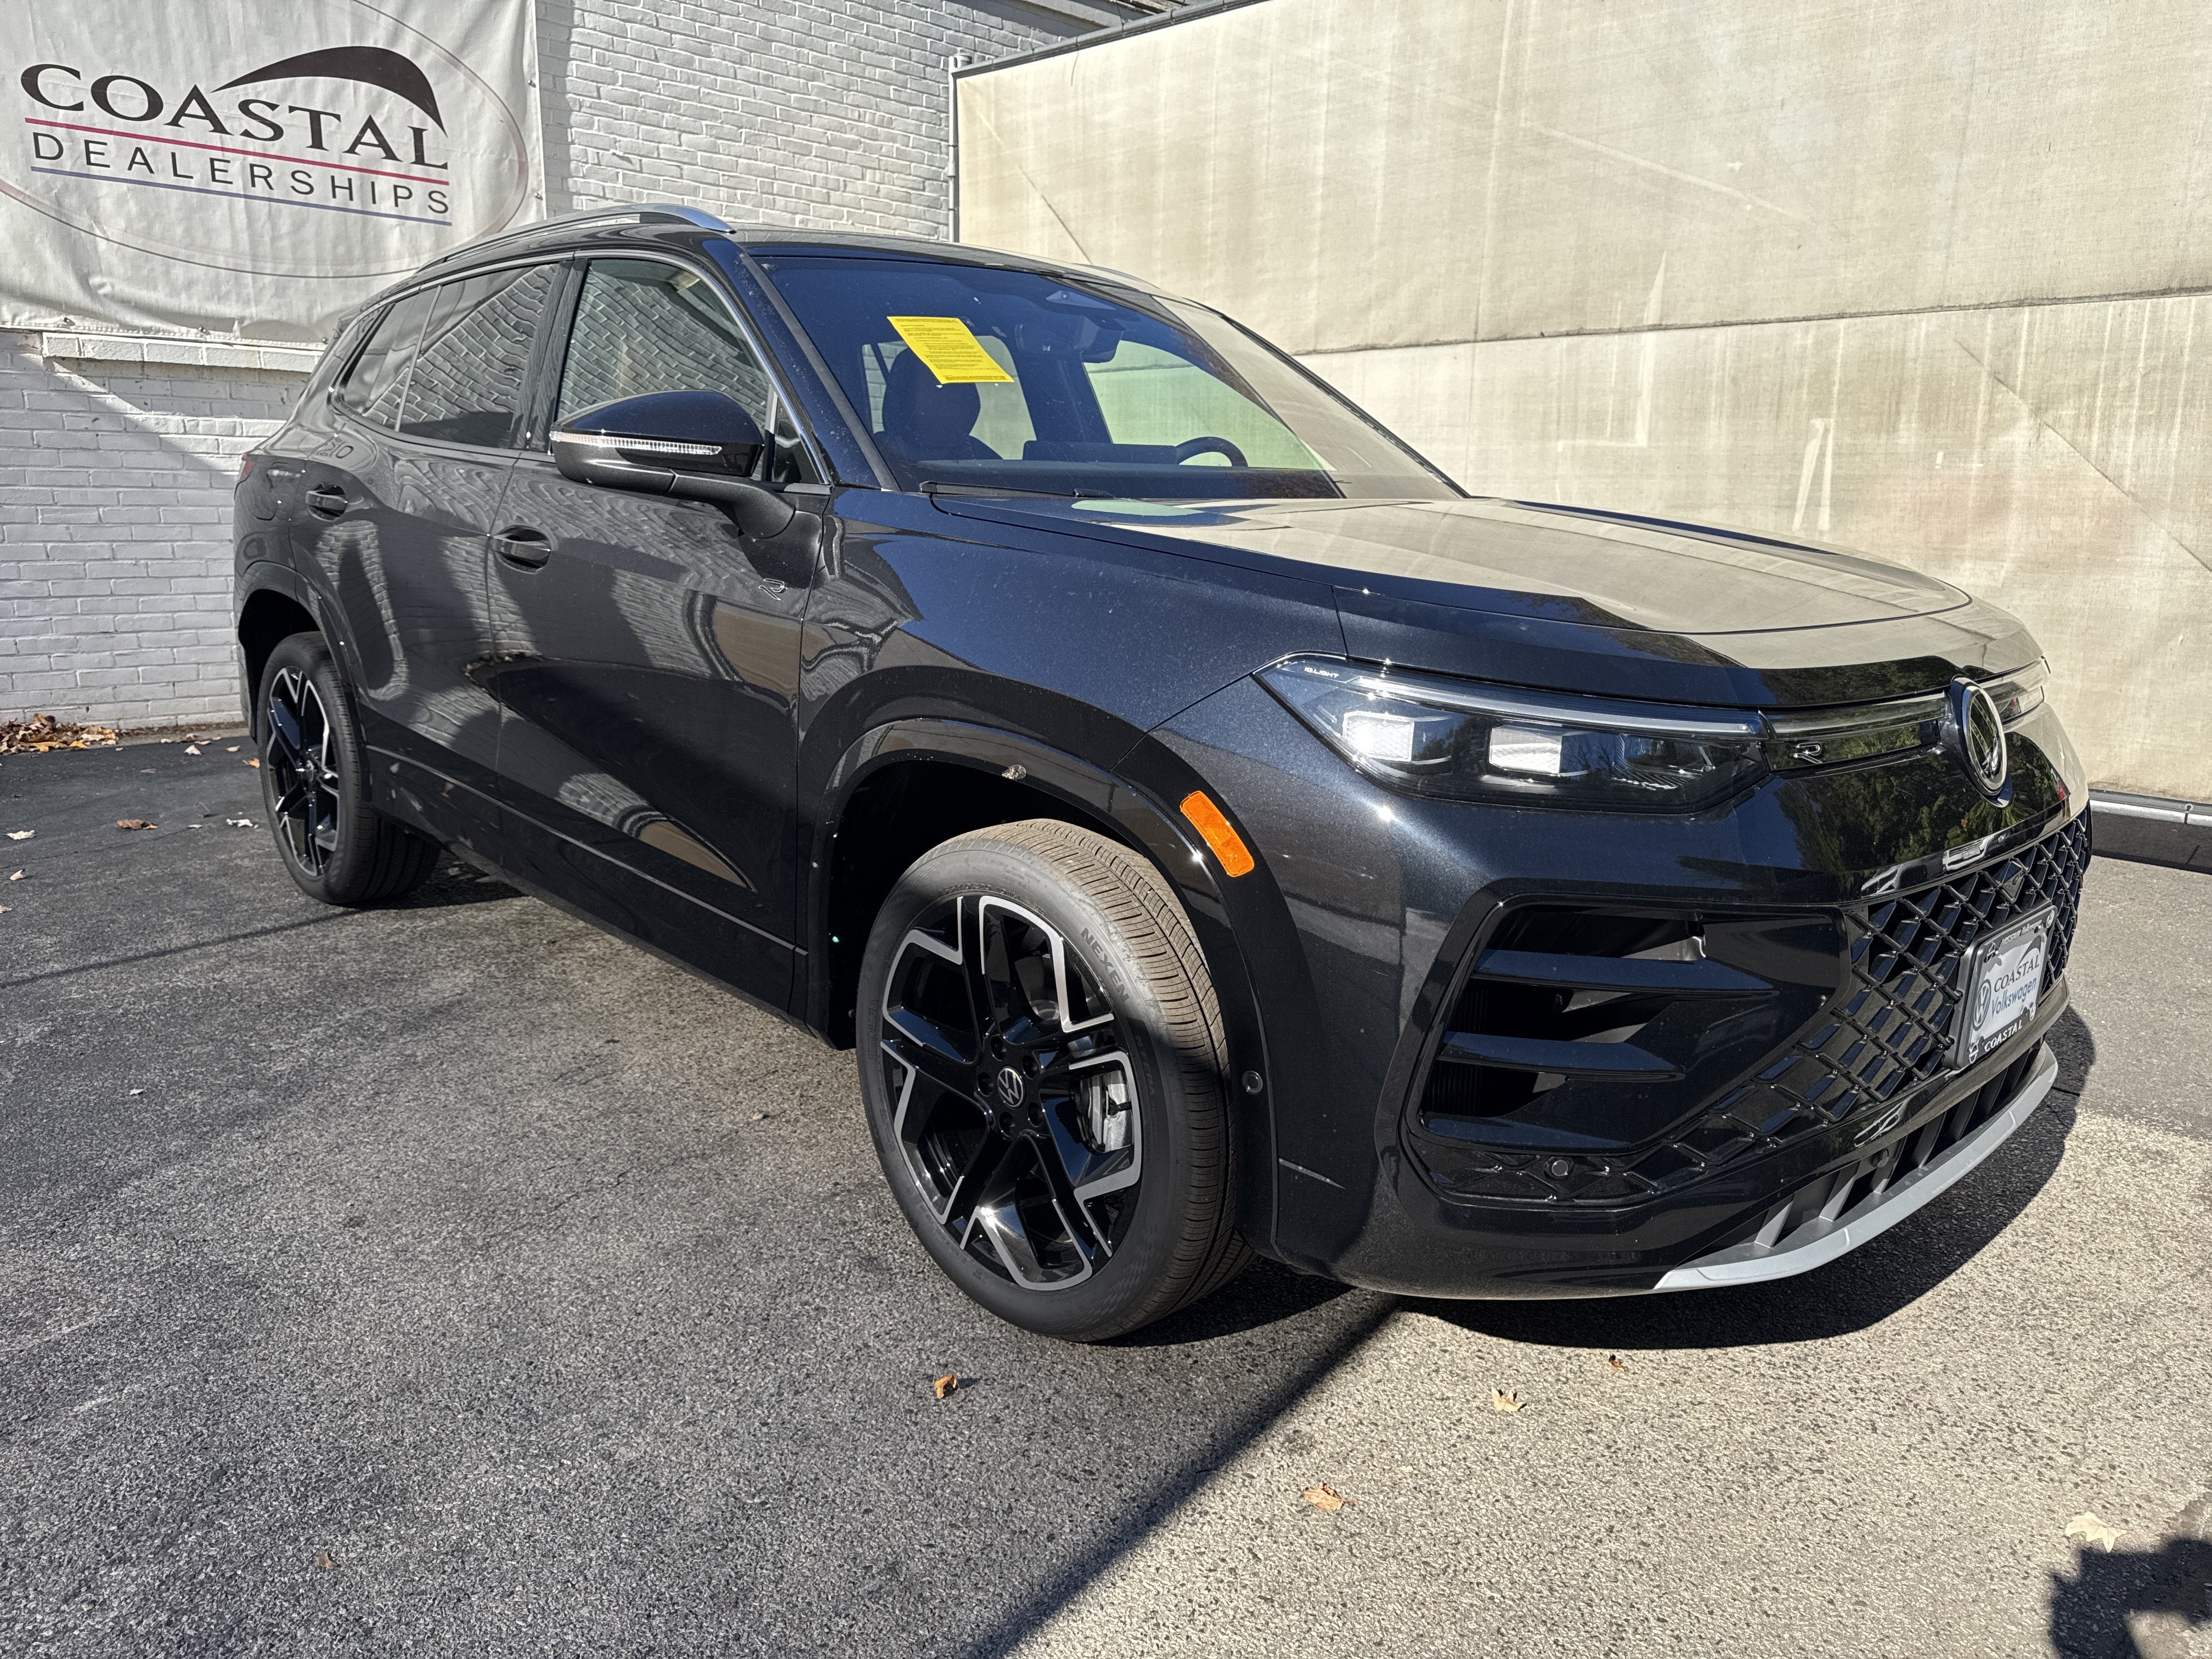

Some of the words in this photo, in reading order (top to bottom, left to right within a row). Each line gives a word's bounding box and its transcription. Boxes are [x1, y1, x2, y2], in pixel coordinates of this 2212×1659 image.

[20, 64, 449, 170] COASTAL
[33, 132, 449, 214] DEALERSHIPS
[1080, 927, 1130, 1002] NEXEN
[1994, 954, 2040, 992] COASTAL
[1991, 977, 2037, 1018] Volkswagen
[1984, 1019, 2023, 1052] COASTAL
